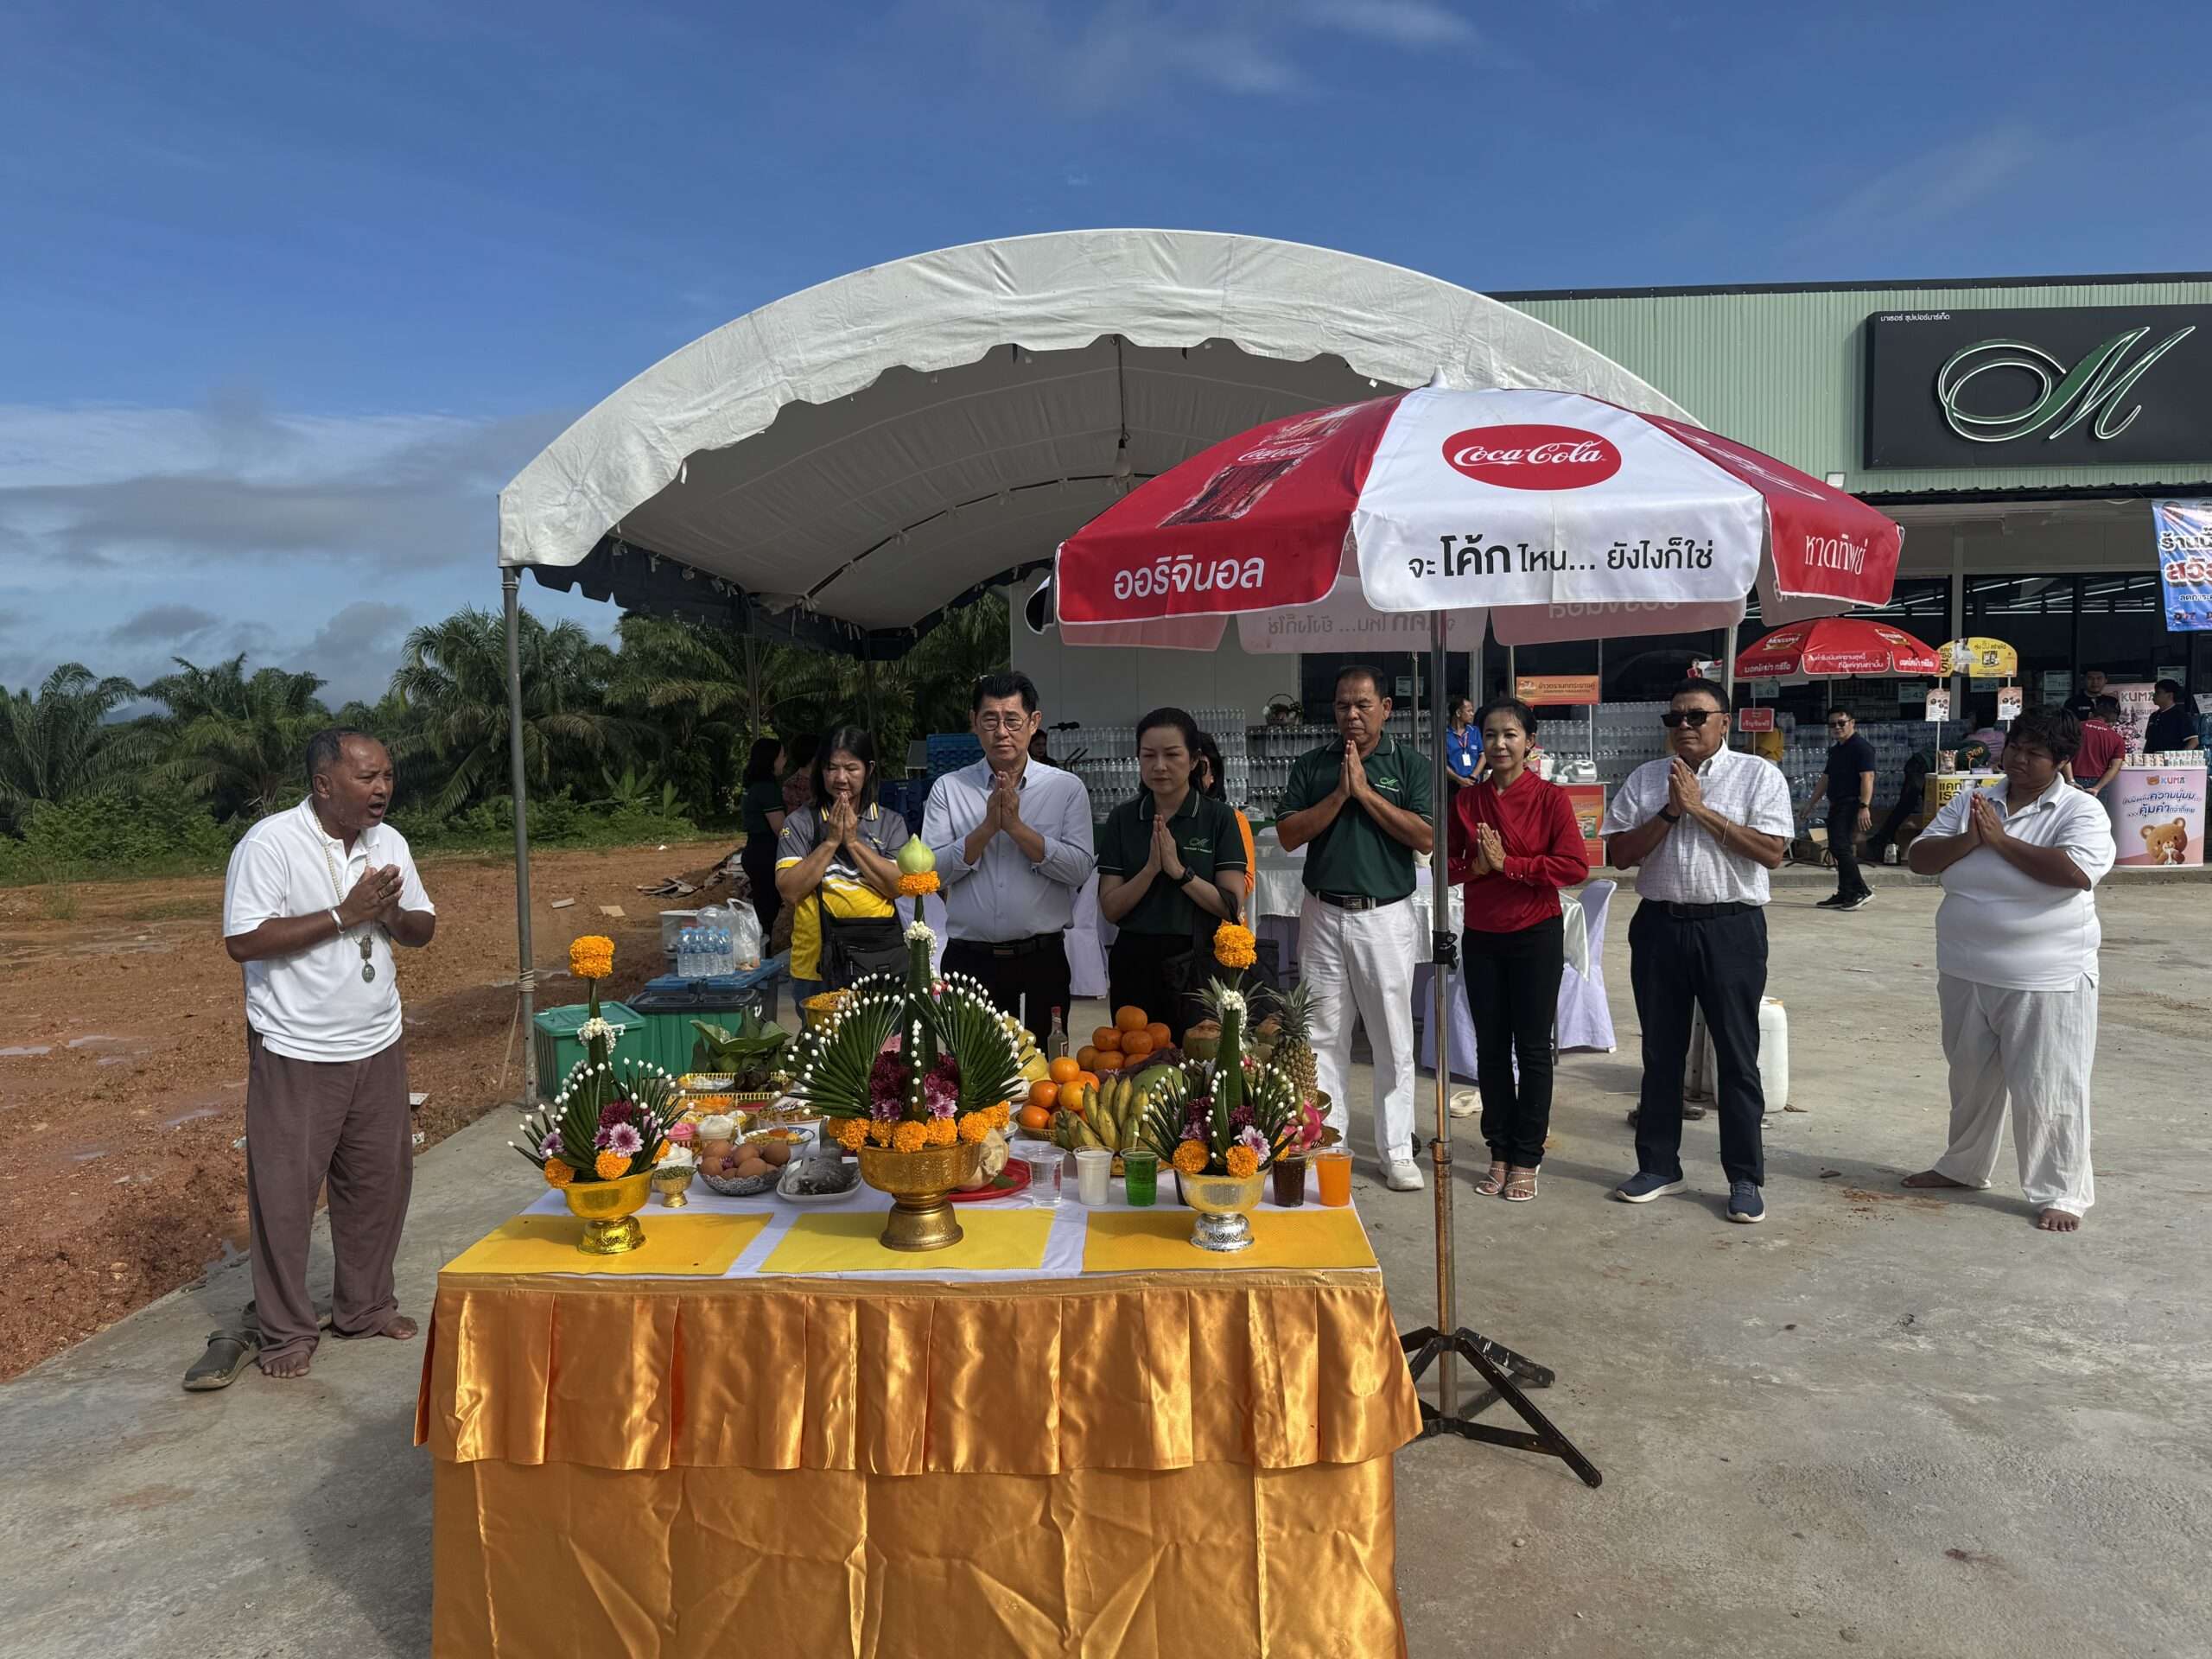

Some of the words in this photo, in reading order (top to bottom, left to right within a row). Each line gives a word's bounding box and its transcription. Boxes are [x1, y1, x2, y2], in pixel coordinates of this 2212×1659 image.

[1453, 440, 1604, 467] Coca-Cola
[1408, 557, 1436, 578] จะ
[1440, 534, 1511, 576] โค้ก
[1517, 543, 1596, 572] ไหน...
[1607, 537, 1713, 570] ยังไงก็ใช่
[1805, 534, 1868, 575] หาดทิพย์
[1114, 554, 1264, 600] ออริจินอล
